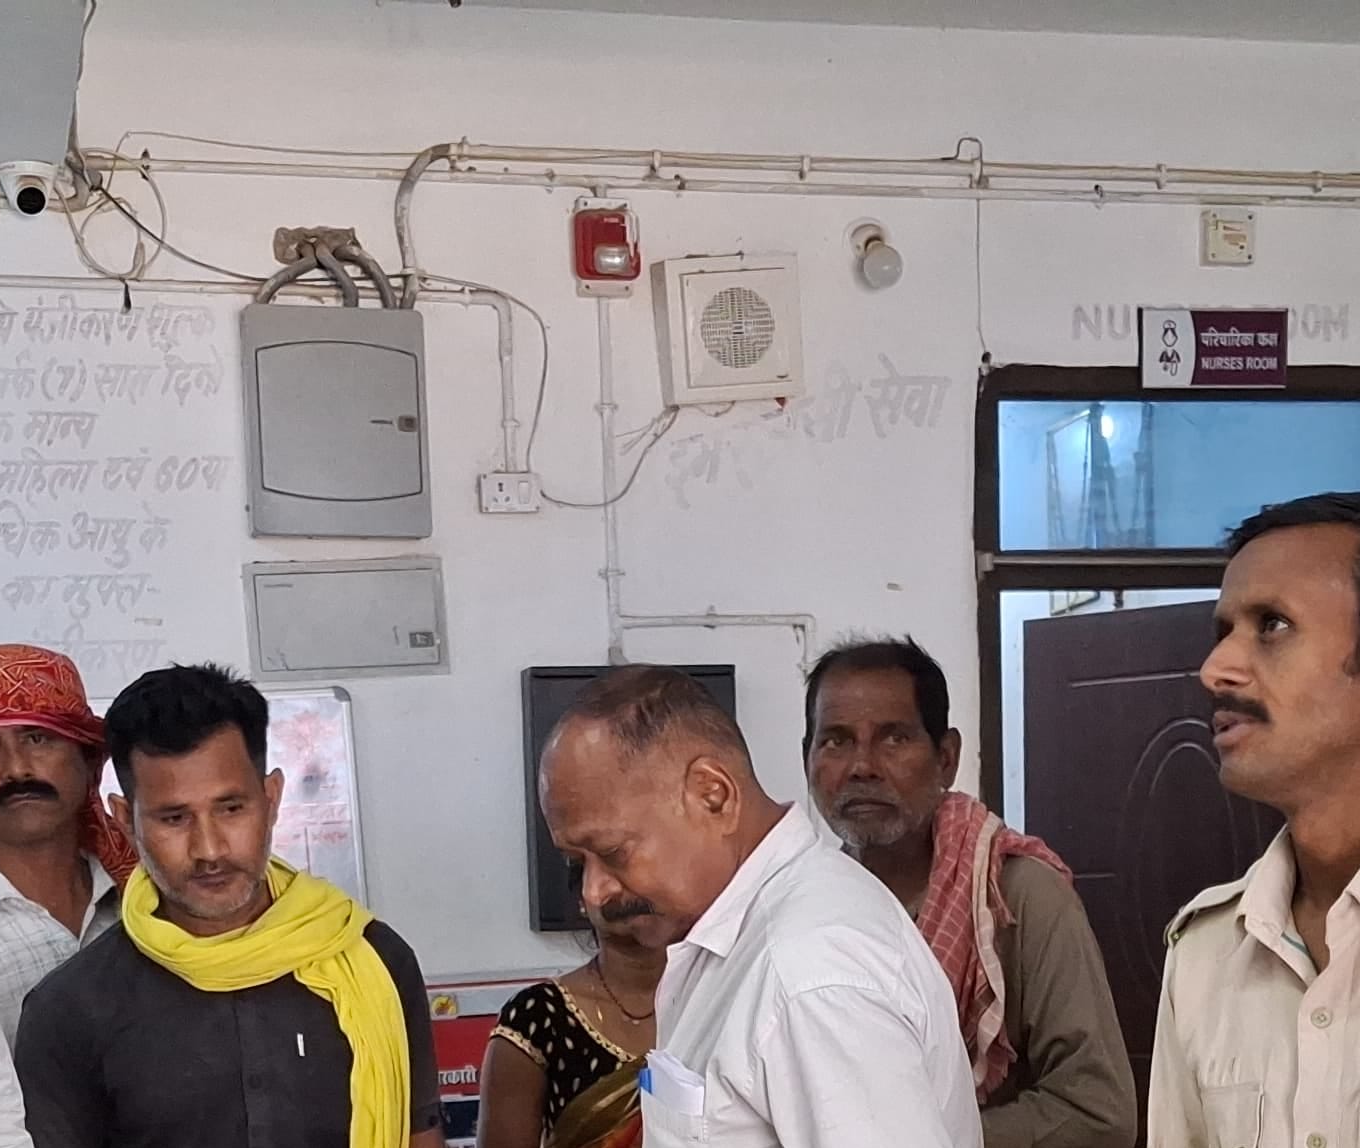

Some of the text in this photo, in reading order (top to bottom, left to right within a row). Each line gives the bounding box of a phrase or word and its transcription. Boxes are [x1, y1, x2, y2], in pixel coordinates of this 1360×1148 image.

[1201, 357, 1278, 370] NURSES ROOM
[438, 1065, 477, 1085] रकारी
